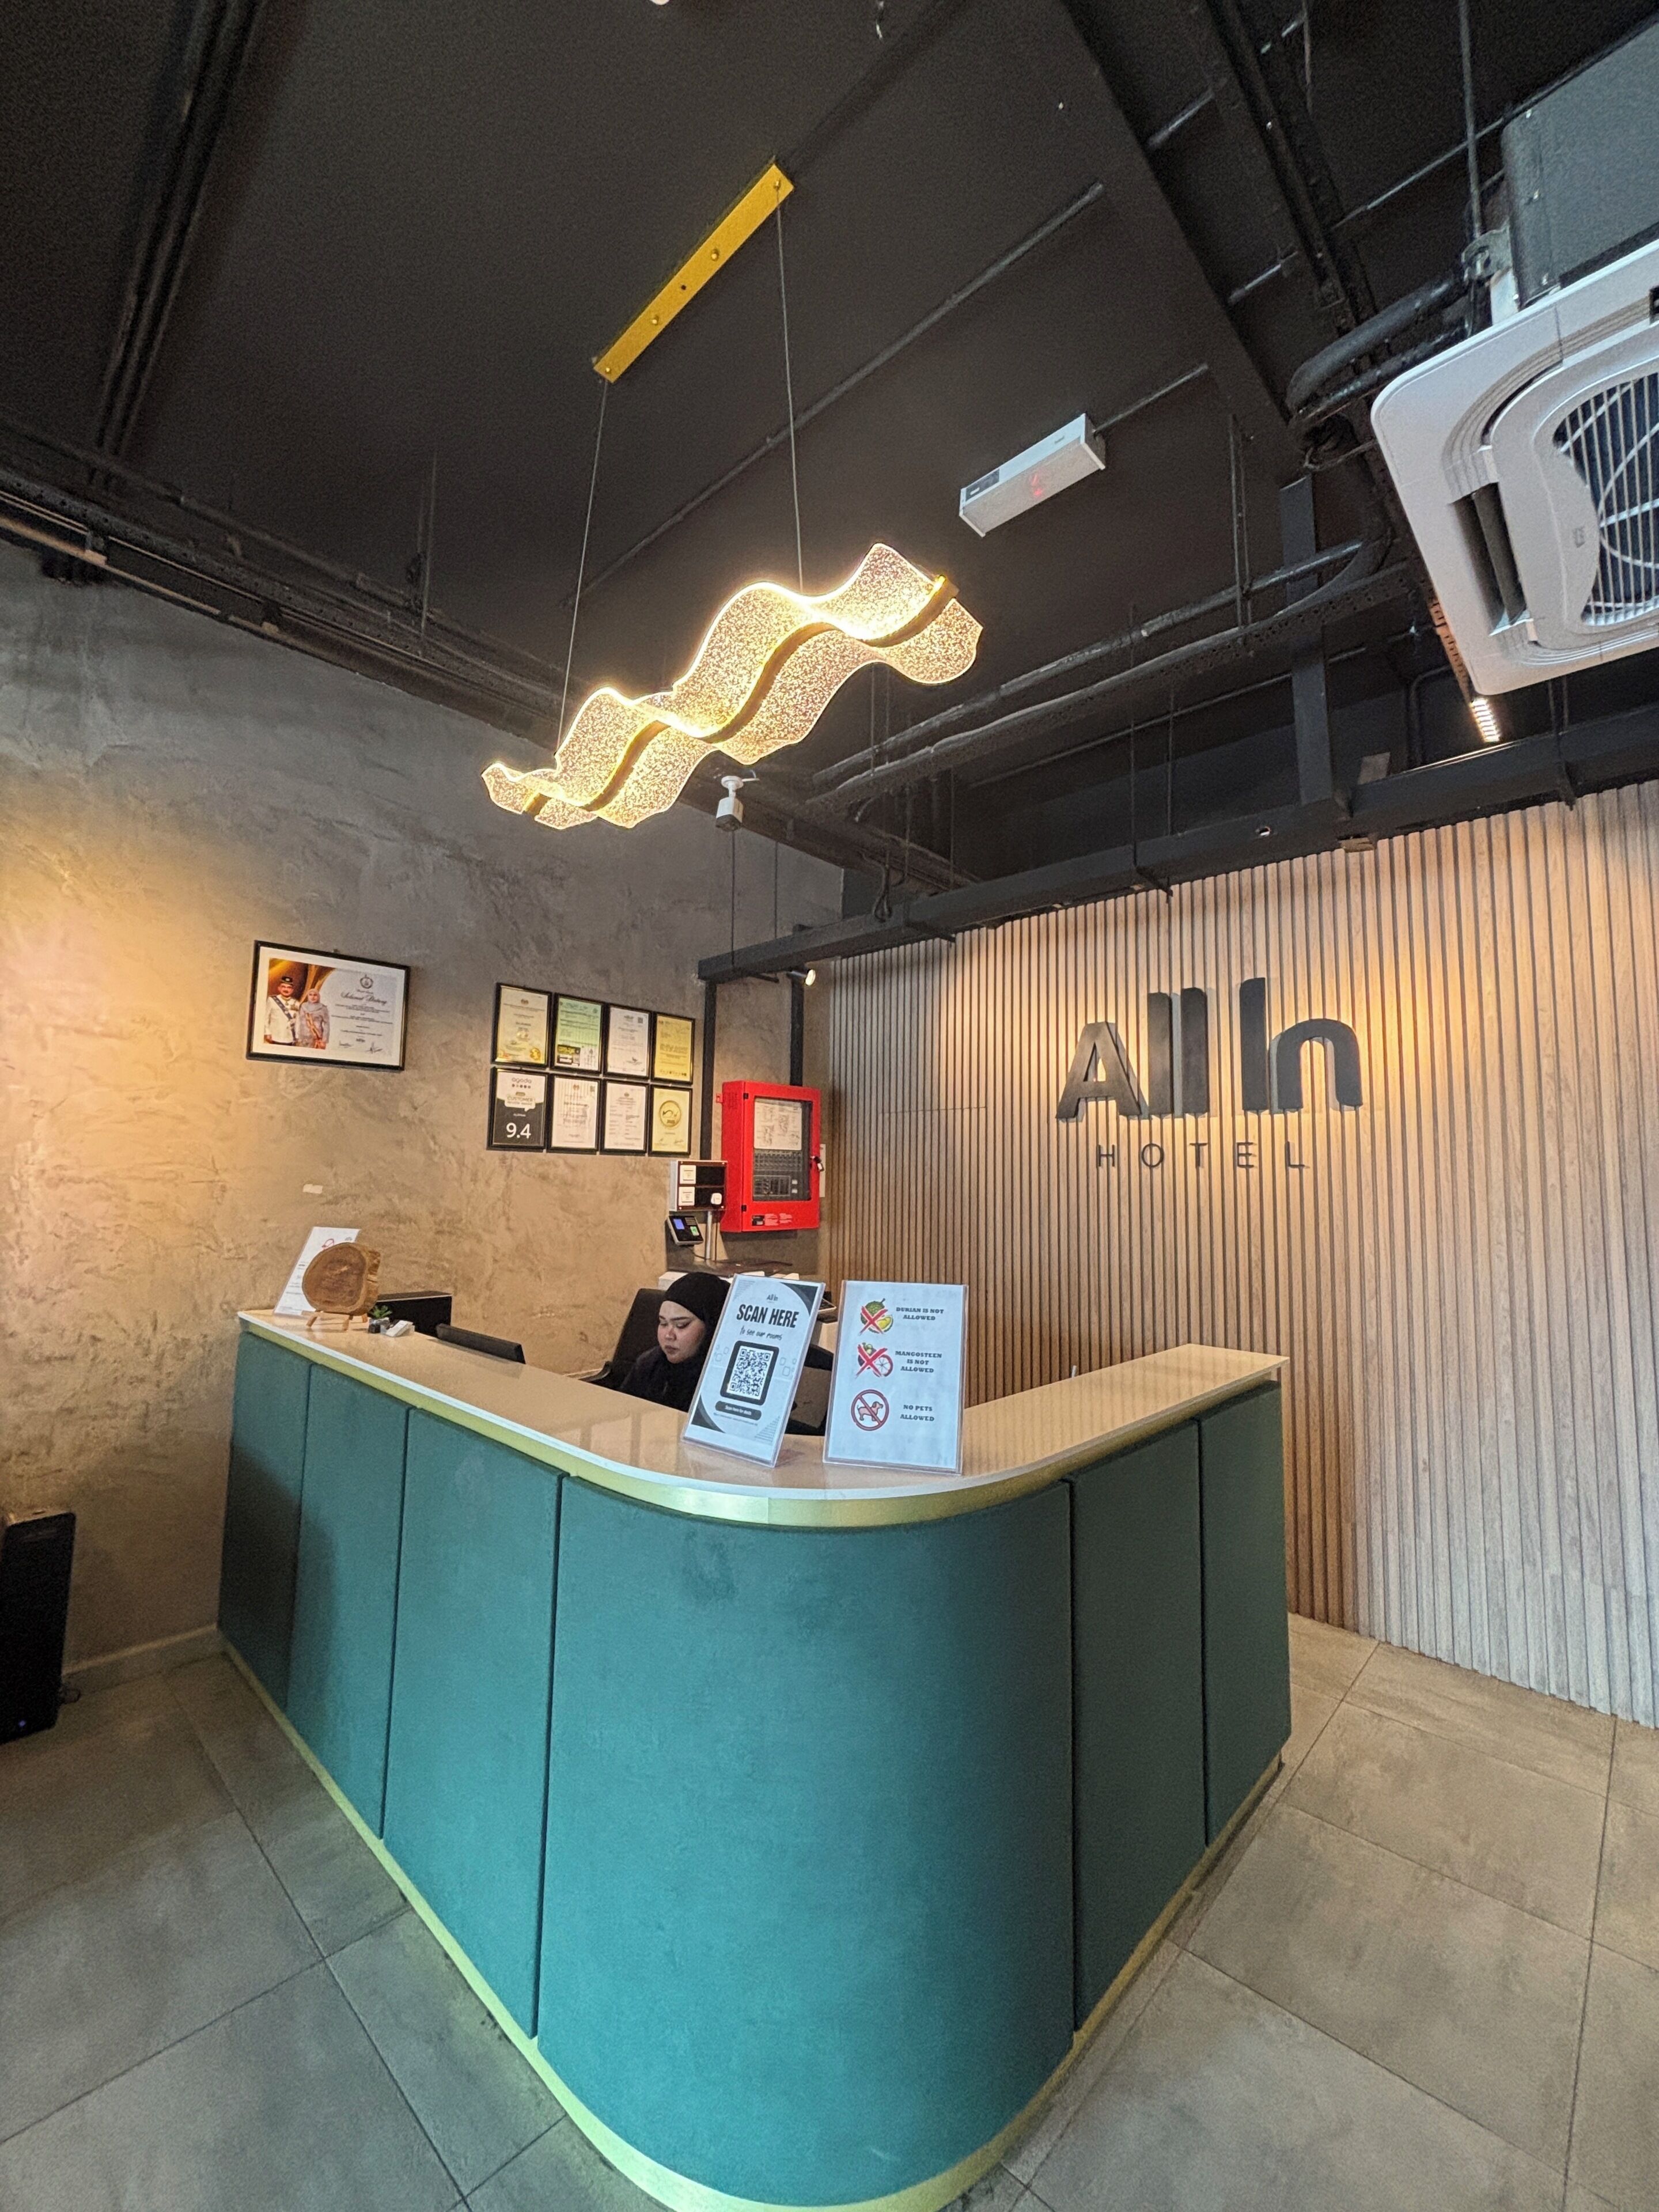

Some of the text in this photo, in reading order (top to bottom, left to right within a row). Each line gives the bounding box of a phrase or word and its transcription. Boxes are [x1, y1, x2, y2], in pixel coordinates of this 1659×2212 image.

[1055, 987, 1210, 1119] All
[506, 1122, 531, 1139] 9.4
[1096, 1141, 1309, 1168] HOTEL
[737, 1304, 799, 1328] SCAN HERE
[766, 1333, 782, 1341] rooms
[900, 1414, 935, 1422] ALLOWED
